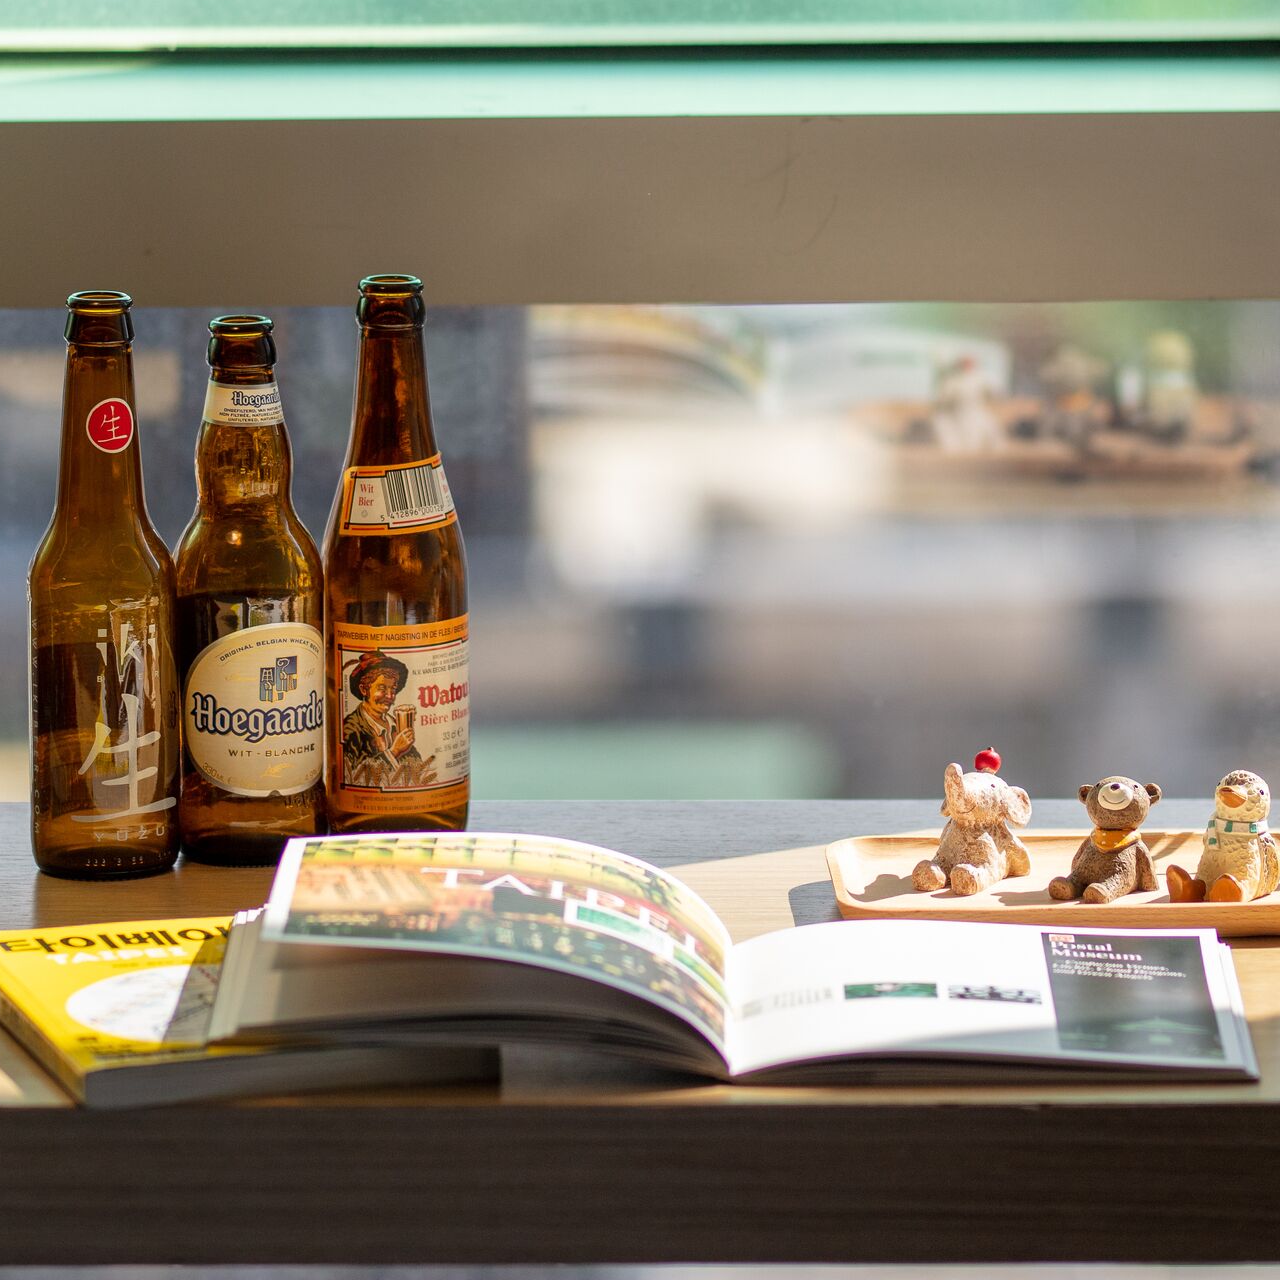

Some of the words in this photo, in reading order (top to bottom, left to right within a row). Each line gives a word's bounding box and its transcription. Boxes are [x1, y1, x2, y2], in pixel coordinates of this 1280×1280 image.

[97, 405, 128, 443] 生
[360, 483, 374, 494] Wit
[358, 496, 375, 507] Bier
[370, 632, 384, 640] MET
[385, 632, 421, 640] NAGISTING
[422, 631, 428, 639] IN
[429, 630, 437, 638] DE
[95, 623, 157, 667] iki
[219, 643, 254, 662] ORIGINAL
[256, 638, 288, 647] BELGIAN
[289, 638, 309, 647] WHEAT
[420, 713, 449, 727] Bière
[70, 693, 178, 823] 生
[228, 748, 253, 757] WIT
[265, 743, 315, 757] BLANCHE
[93, 824, 165, 842] YUZU
[420, 866, 698, 956] TAIPEI
[1051, 941, 1113, 952] Postal
[45, 946, 189, 965] TAIPEI
[1051, 948, 1143, 962] Museum
